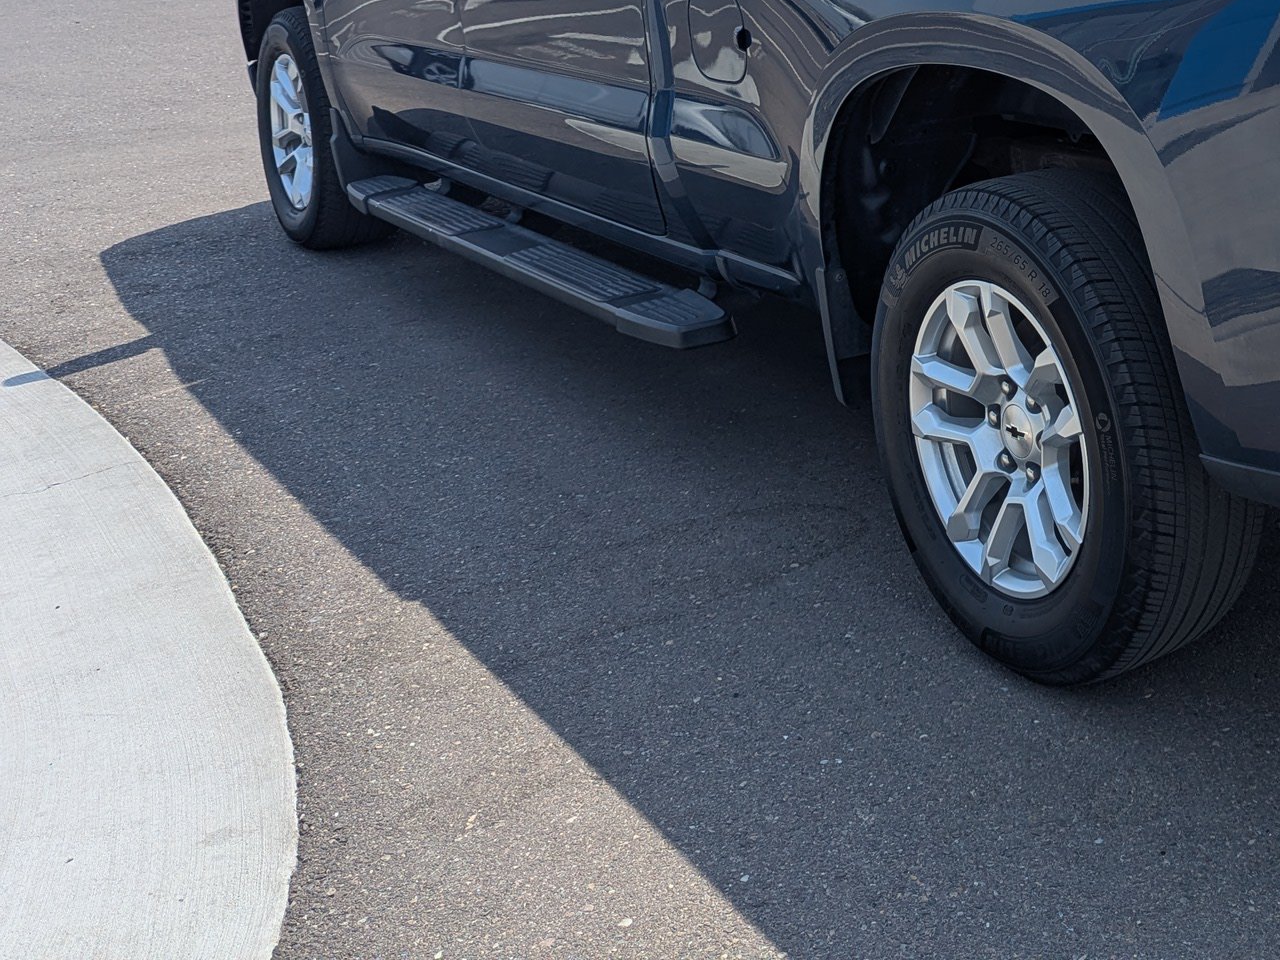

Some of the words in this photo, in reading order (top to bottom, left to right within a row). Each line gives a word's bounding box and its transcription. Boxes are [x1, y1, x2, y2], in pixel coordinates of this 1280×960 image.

[904, 226, 977, 270] MICHELIN
[990, 236, 1029, 271] 265/65
[1027, 271, 1038, 282] R
[1039, 283, 1051, 298] 18
